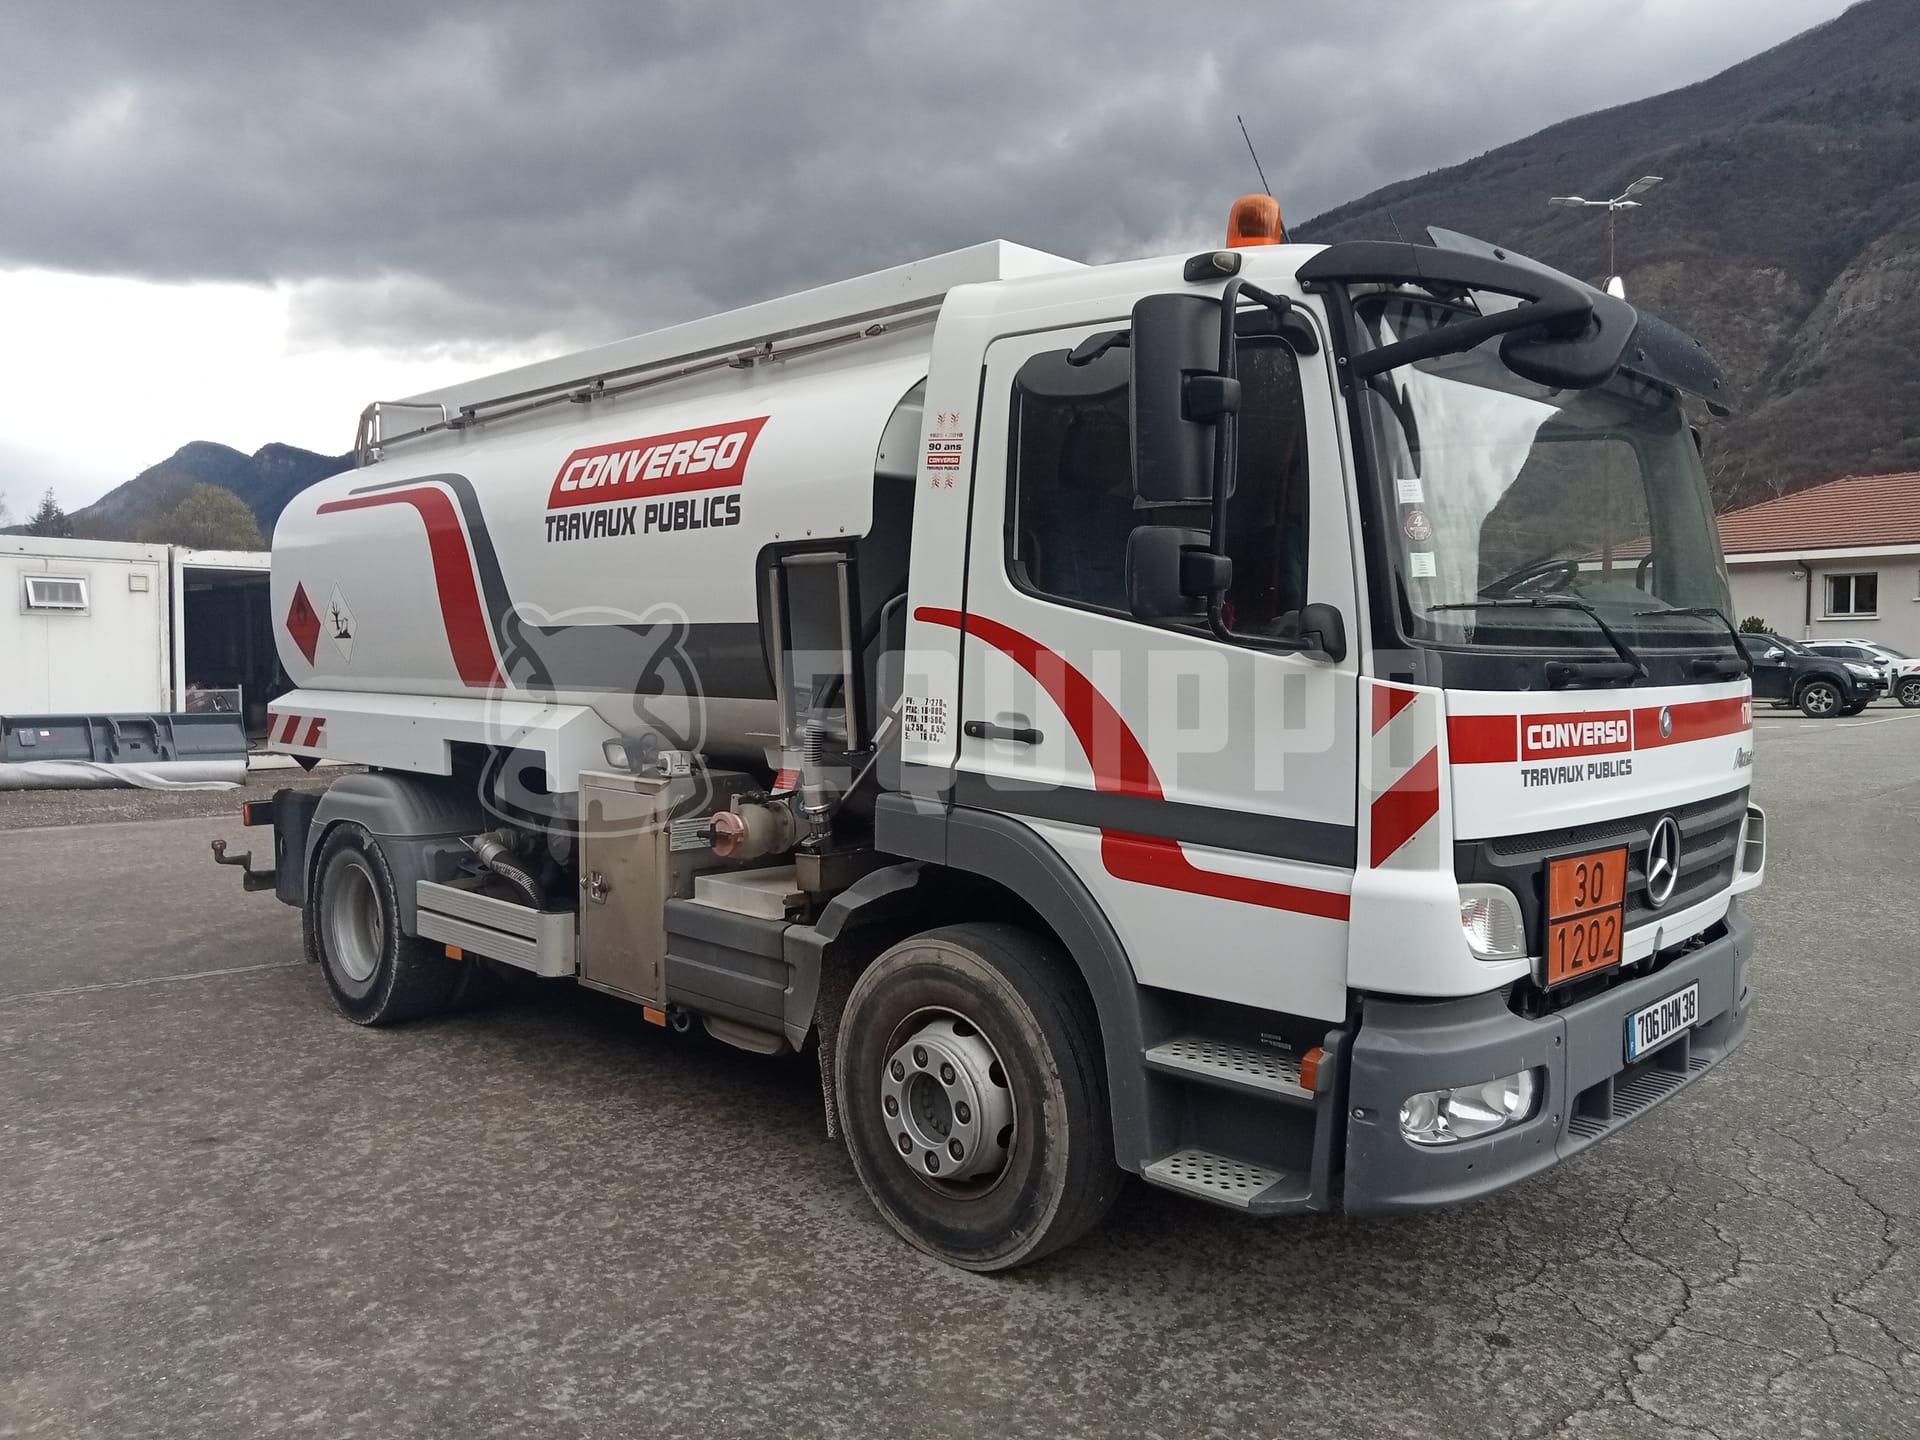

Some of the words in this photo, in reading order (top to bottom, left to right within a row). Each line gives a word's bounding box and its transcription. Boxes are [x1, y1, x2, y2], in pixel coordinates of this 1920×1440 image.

[559, 431, 748, 492] CONVERSO
[928, 443, 942, 451] 90
[545, 505, 637, 543] TRAVAUX
[644, 493, 741, 534] PUBLICS
[1527, 719, 1628, 750] CONVERSO
[1520, 764, 1584, 788] TRAVAUX
[1587, 758, 1633, 781] PUBLICS
[1574, 862, 1604, 908] 30
[1557, 915, 1616, 974] 1202
[1637, 1008, 1660, 1048] 706
[1660, 996, 1681, 1036] DHN
[1682, 989, 1696, 1023] 38
